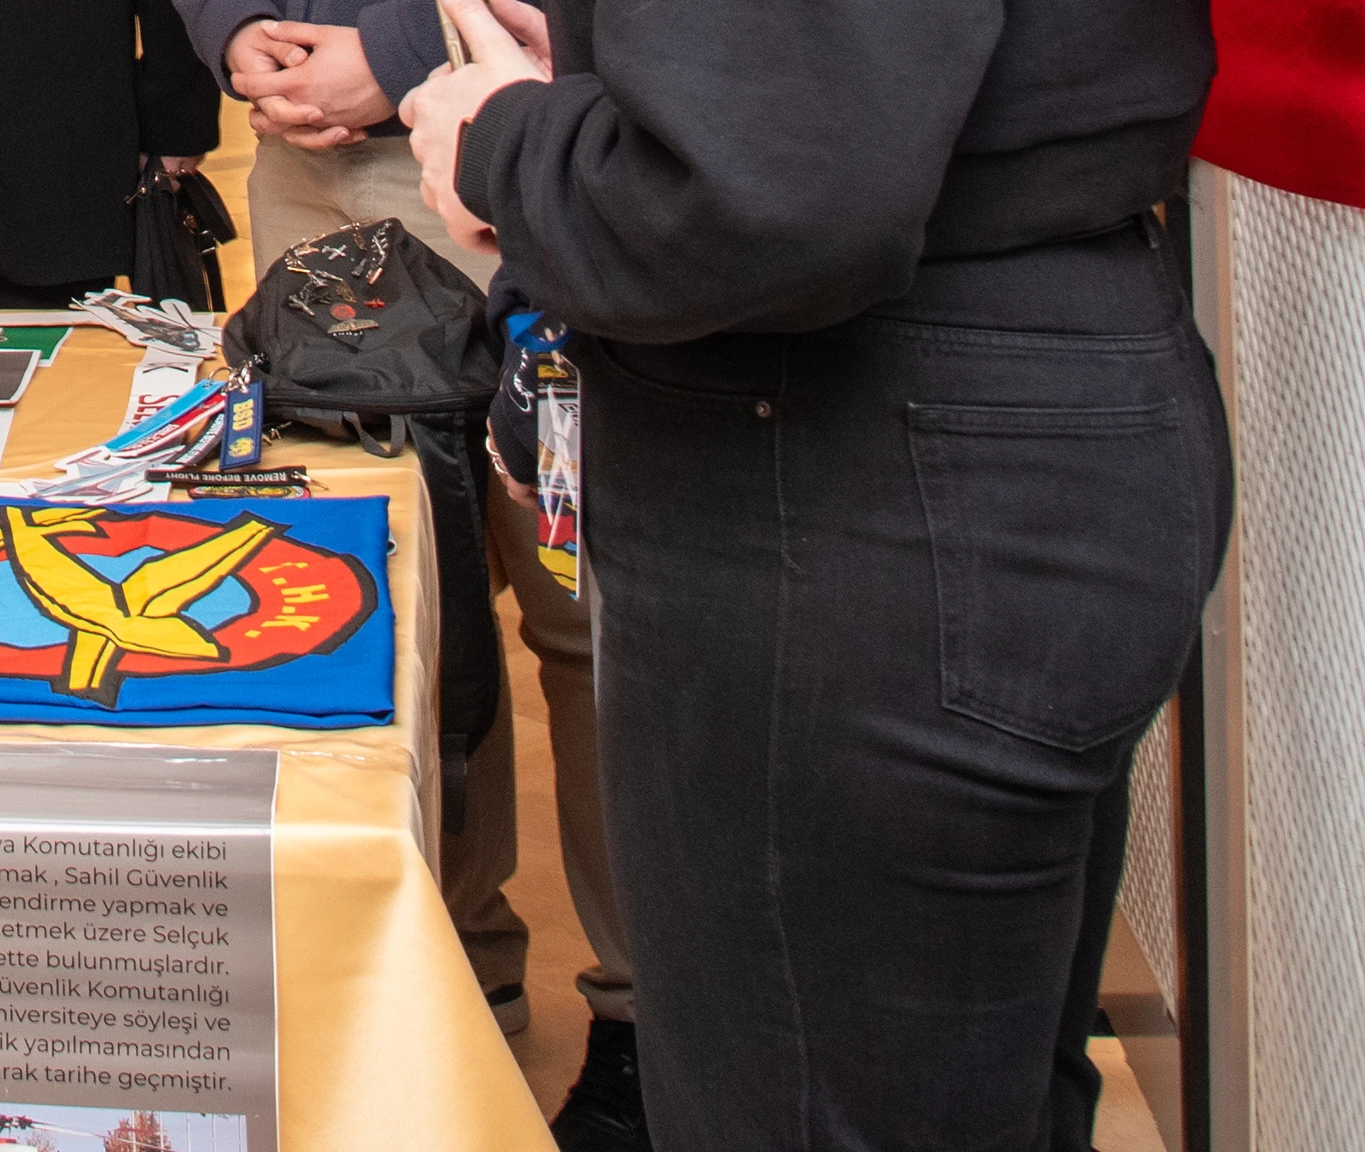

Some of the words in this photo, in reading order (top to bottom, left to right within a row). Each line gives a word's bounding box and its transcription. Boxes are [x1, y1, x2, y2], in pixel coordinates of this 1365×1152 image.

[165, 472, 200, 481] FLIGHT
[202, 473, 242, 482] BEFORE
[243, 471, 287, 482] REMOVE
[23, 835, 164, 862] Komutanlığı
[171, 840, 227, 860] ekibi
[65, 866, 119, 886] Sahil
[126, 868, 228, 890] Güvenlik
[101, 898, 196, 917] yapmak
[202, 901, 229, 917] ve
[1, 921, 77, 940] etmek
[83, 922, 146, 943] üzere
[152, 925, 229, 949] Selçuk
[46, 949, 230, 977] bulunmuşlardır.
[87, 980, 229, 1007] Komutanlığı
[123, 1009, 197, 1034] söyleşi
[204, 1014, 231, 1032] ve
[23, 1034, 230, 1061] yapılmamasından
[45, 1064, 111, 1084] tarihe
[118, 1070, 232, 1094] geçmiştir.
